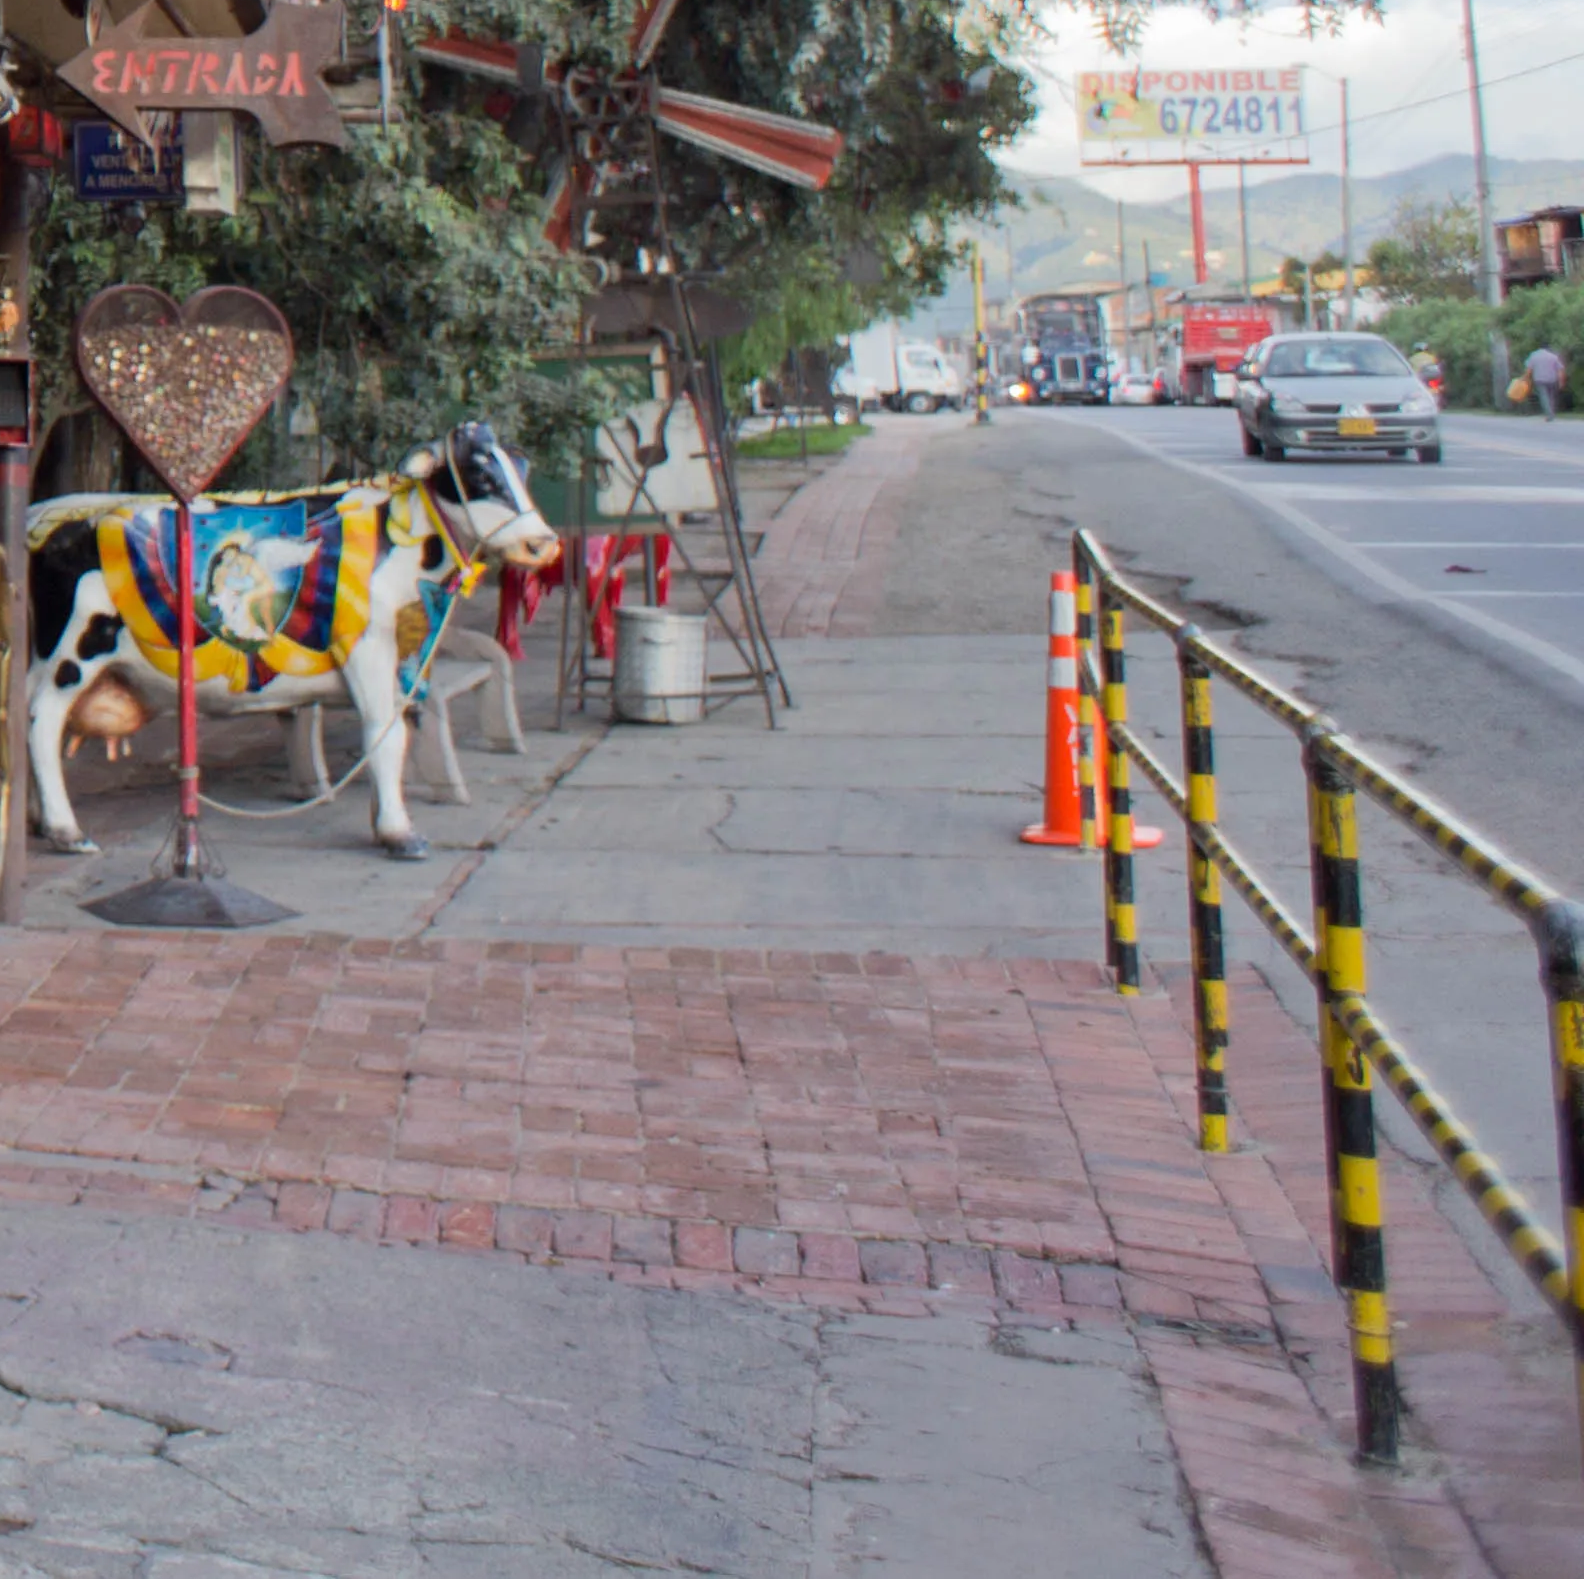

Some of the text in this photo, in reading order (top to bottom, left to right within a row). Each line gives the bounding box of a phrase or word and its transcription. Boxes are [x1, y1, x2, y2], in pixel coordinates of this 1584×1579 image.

[91, 49, 307, 97] ENTRADA
[1082, 71, 1301, 92] DISPONIBLE
[1159, 95, 1304, 134] 6724811
